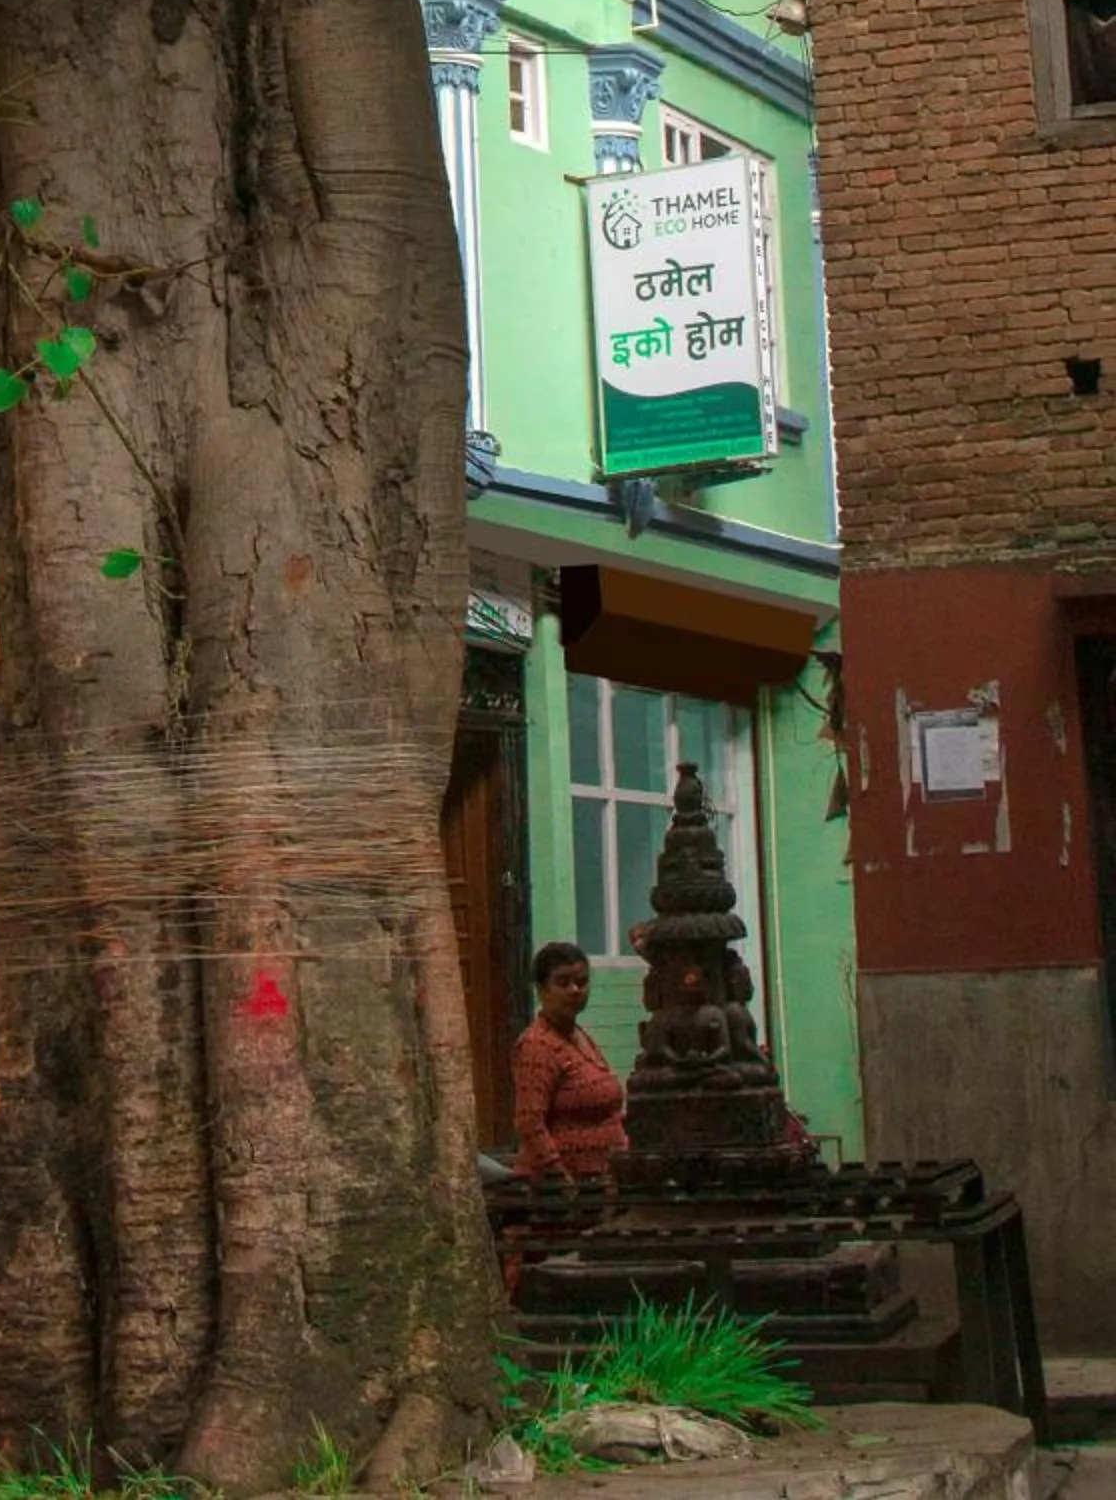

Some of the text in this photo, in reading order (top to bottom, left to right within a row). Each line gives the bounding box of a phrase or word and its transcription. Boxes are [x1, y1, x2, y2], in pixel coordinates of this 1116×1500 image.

[650, 187, 741, 217] THAMEL
[654, 209, 740, 237] ECO HOME
[633, 258, 715, 301] ठमेल
[610, 311, 745, 368] इको होम
